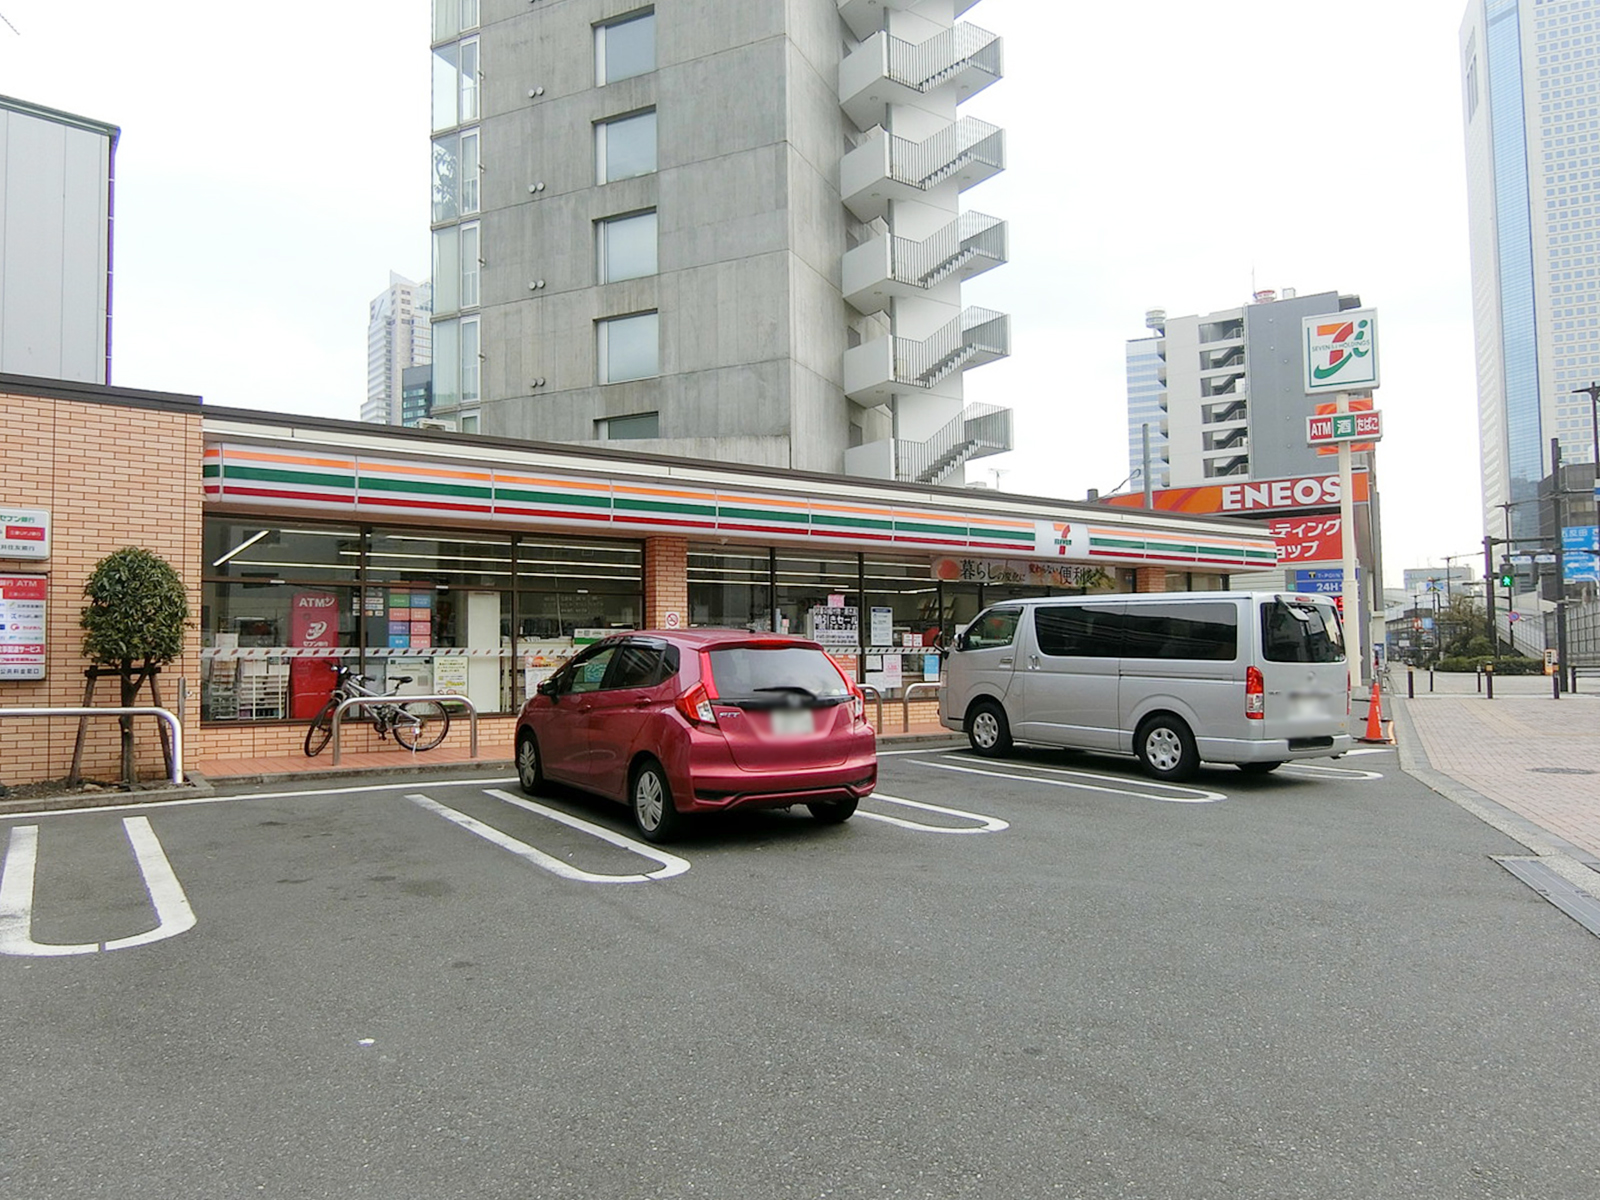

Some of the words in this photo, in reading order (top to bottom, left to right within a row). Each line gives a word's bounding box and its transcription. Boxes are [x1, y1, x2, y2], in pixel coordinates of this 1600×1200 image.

[1311, 422, 1331, 436] ATM
[1337, 419, 1351, 434] 酒
[1357, 417, 1379, 432] たばこ
[1222, 477, 1341, 510] ENEOS
[0, 515, 35, 523] セブン銀行
[1269, 519, 1341, 538] ティング
[1054, 538, 1072, 546] ELEVEN
[1316, 582, 1339, 592] 24H
[300, 598, 325, 607] ATM
